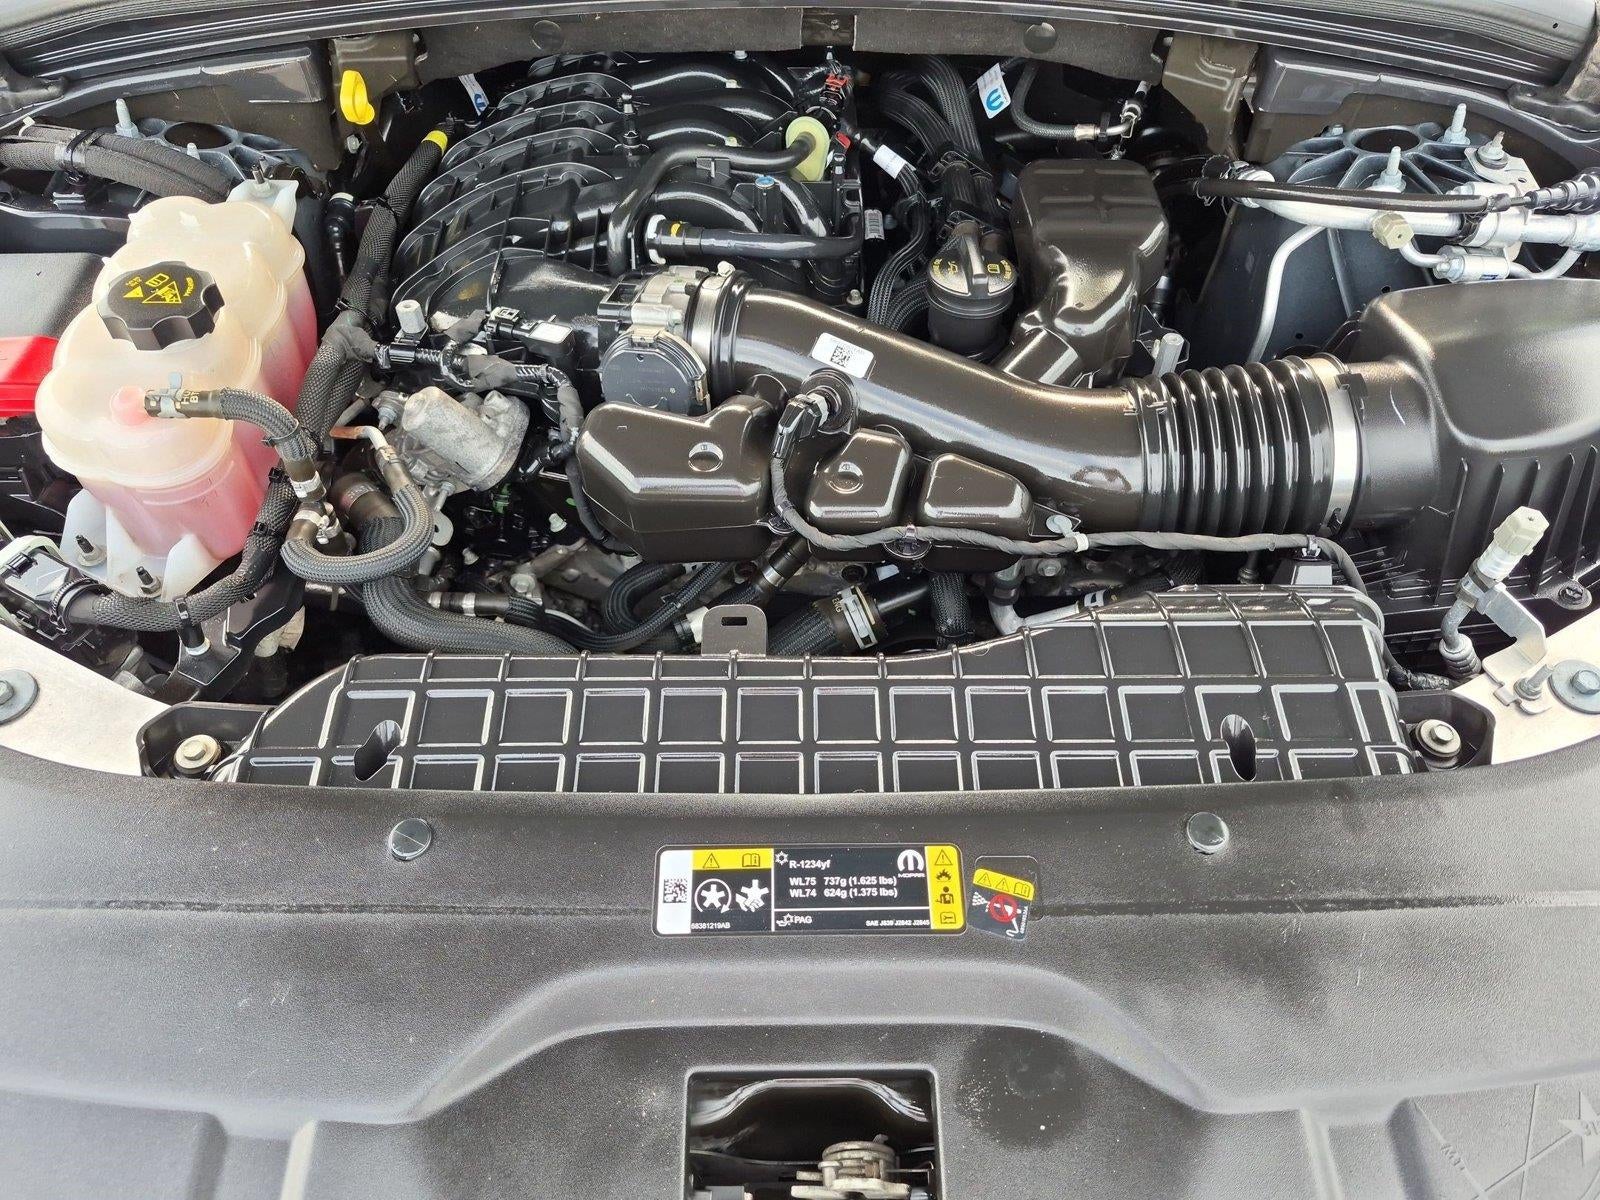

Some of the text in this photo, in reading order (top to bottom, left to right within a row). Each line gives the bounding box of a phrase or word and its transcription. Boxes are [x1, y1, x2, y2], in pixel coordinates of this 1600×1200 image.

[788, 859, 831, 870] R-1234yf
[789, 875, 898, 887] WL75 737g (1.625 lbs)
[789, 887, 898, 899] WL74 624g (1.375 lbs)
[794, 915, 812, 924] PAG
